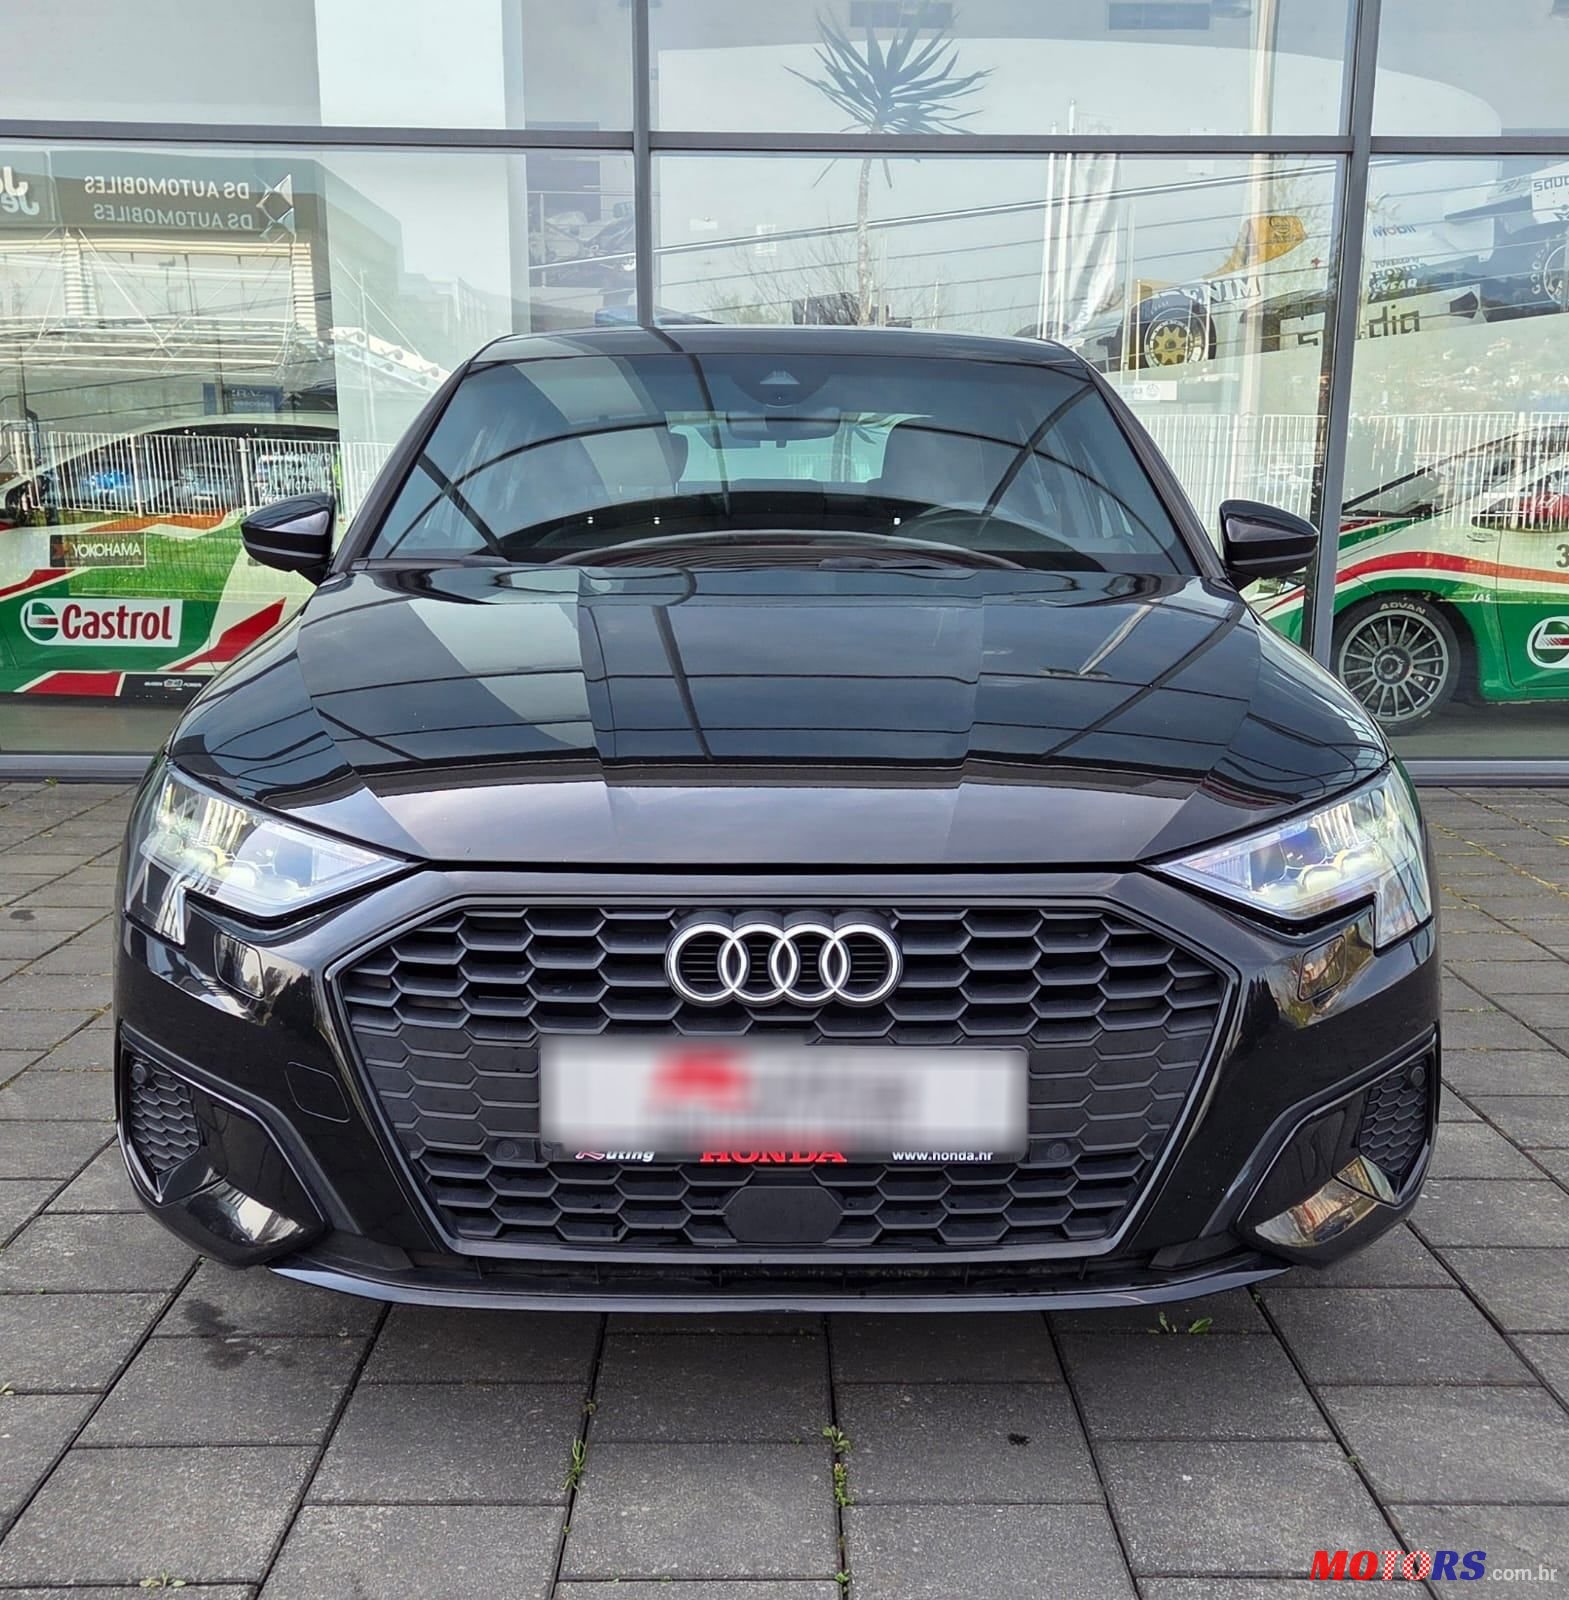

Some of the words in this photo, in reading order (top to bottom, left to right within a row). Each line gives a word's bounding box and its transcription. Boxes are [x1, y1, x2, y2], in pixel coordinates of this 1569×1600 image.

[1372, 223, 1417, 238] Mobil
[72, 541, 142, 558] YOKOHAMA
[1379, 601, 1427, 616] ADVAN
[61, 603, 173, 641] Castrol
